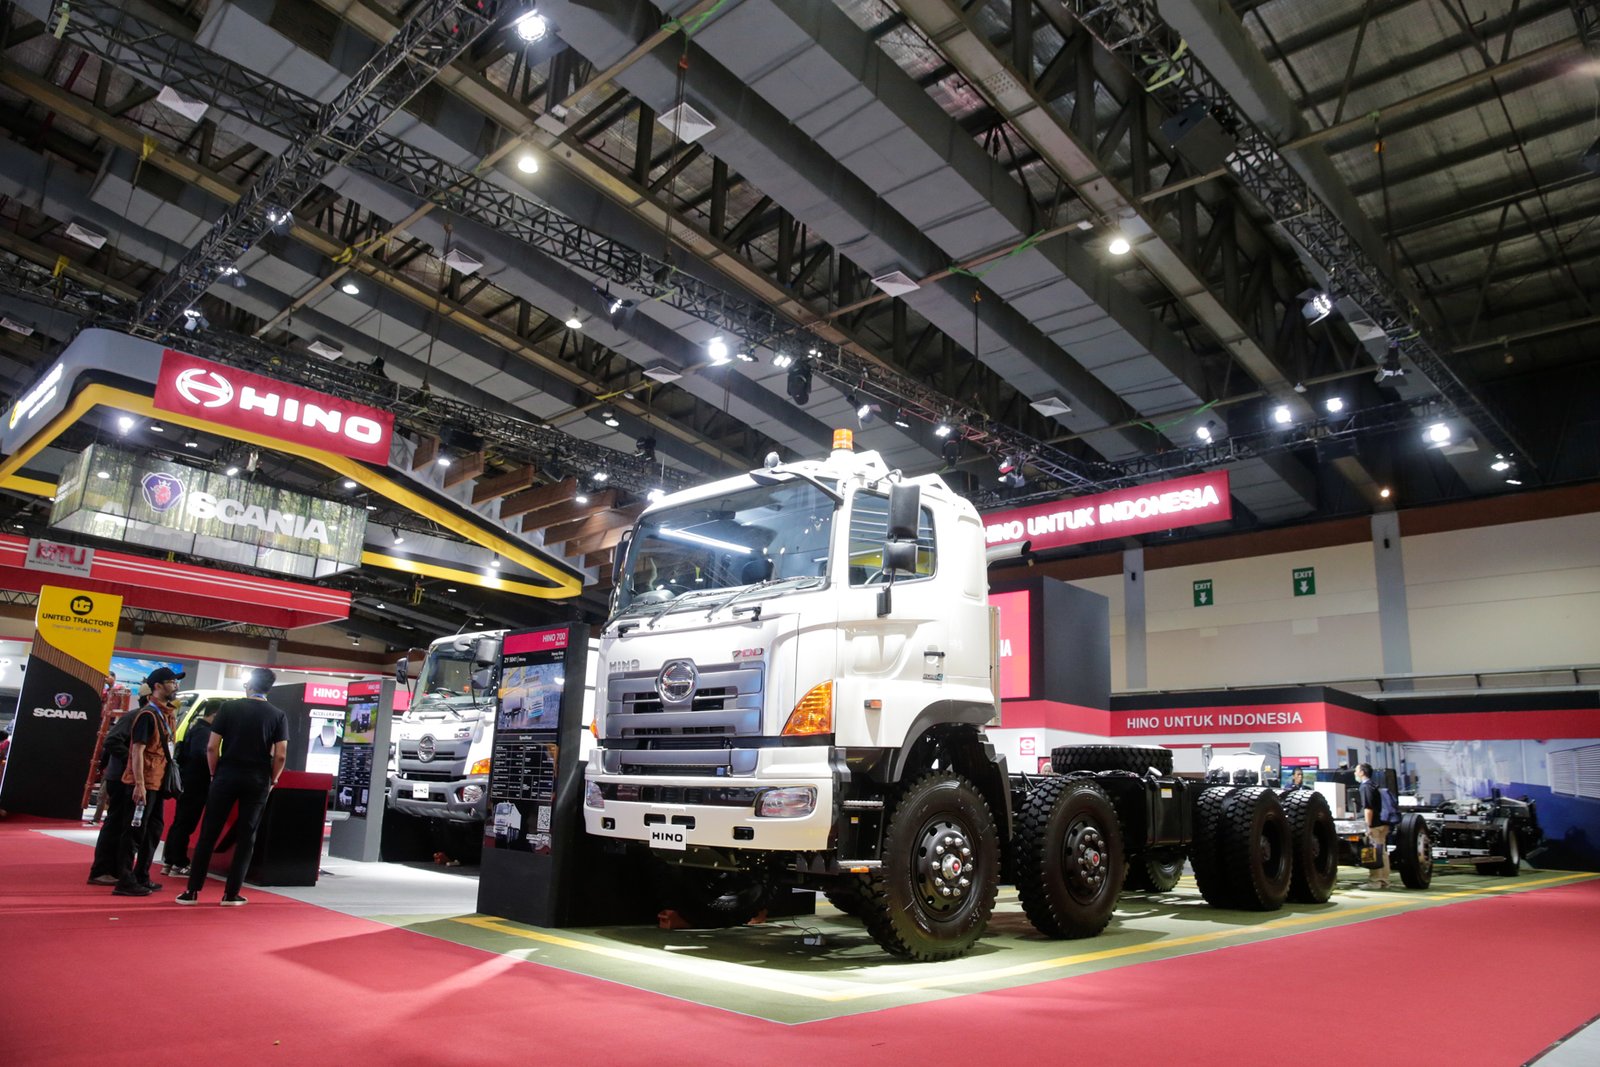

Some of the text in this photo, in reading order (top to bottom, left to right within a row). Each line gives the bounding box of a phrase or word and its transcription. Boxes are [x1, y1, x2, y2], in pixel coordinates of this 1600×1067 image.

[239, 386, 382, 444] HINO
[1027, 507, 1095, 536] UNTUK
[1099, 485, 1220, 524] INDONESIA
[187, 491, 329, 544] SCANIA
[1294, 570, 1313, 579] EXIT
[1194, 582, 1212, 591] EXIT
[42, 613, 114, 628] UNITED TRACTORS
[542, 632, 566, 643] HINO 700
[732, 648, 764, 658] 700
[608, 659, 640, 672] HINO
[313, 687, 340, 699] HINO
[33, 707, 87, 720] SCANIA
[1127, 712, 1302, 729] HINO UNTUK INDONESIA
[652, 831, 683, 843] HINO
